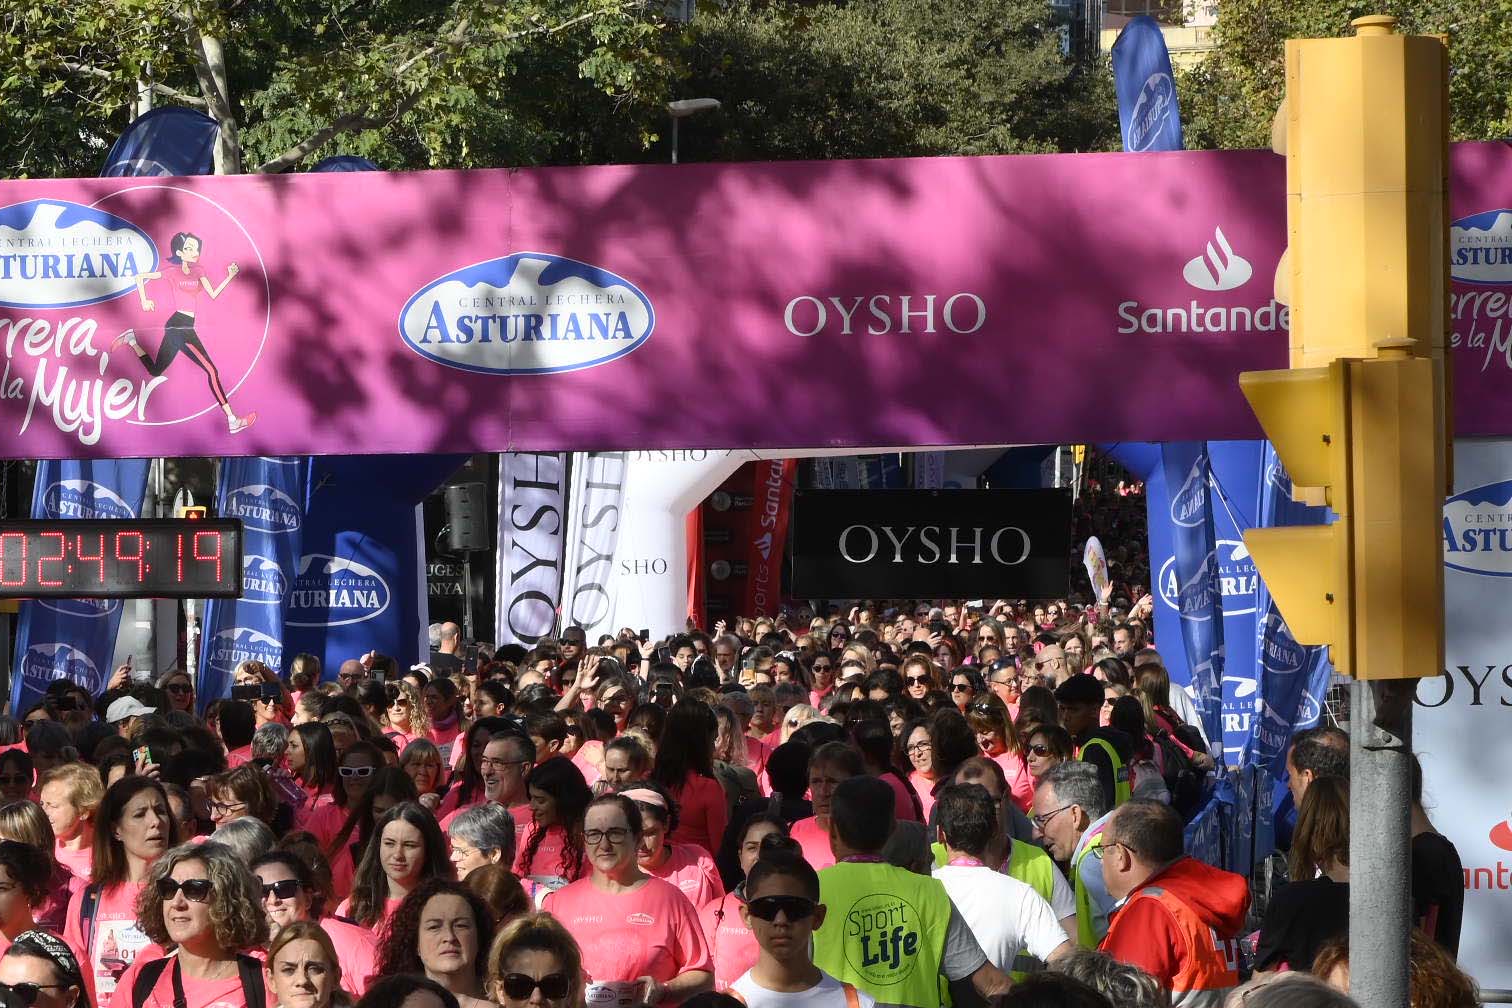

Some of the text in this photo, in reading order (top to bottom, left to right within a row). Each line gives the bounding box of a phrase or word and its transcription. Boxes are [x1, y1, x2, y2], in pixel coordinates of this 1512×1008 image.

[61, 236, 134, 248] LECHERA
[459, 292, 626, 309] CENTRAL LECHERA
[784, 293, 987, 337] OYSHO
[419, 300, 634, 344] ASTURIANA
[1468, 320, 1486, 348] la
[0, 359, 25, 400] la
[19, 351, 169, 446] Mujer
[0, 531, 221, 586] 02:49:19
[839, 525, 1031, 565] OYSHO
[621, 558, 668, 576] SHO
[849, 902, 907, 938] Sport
[860, 926, 918, 969] Life
